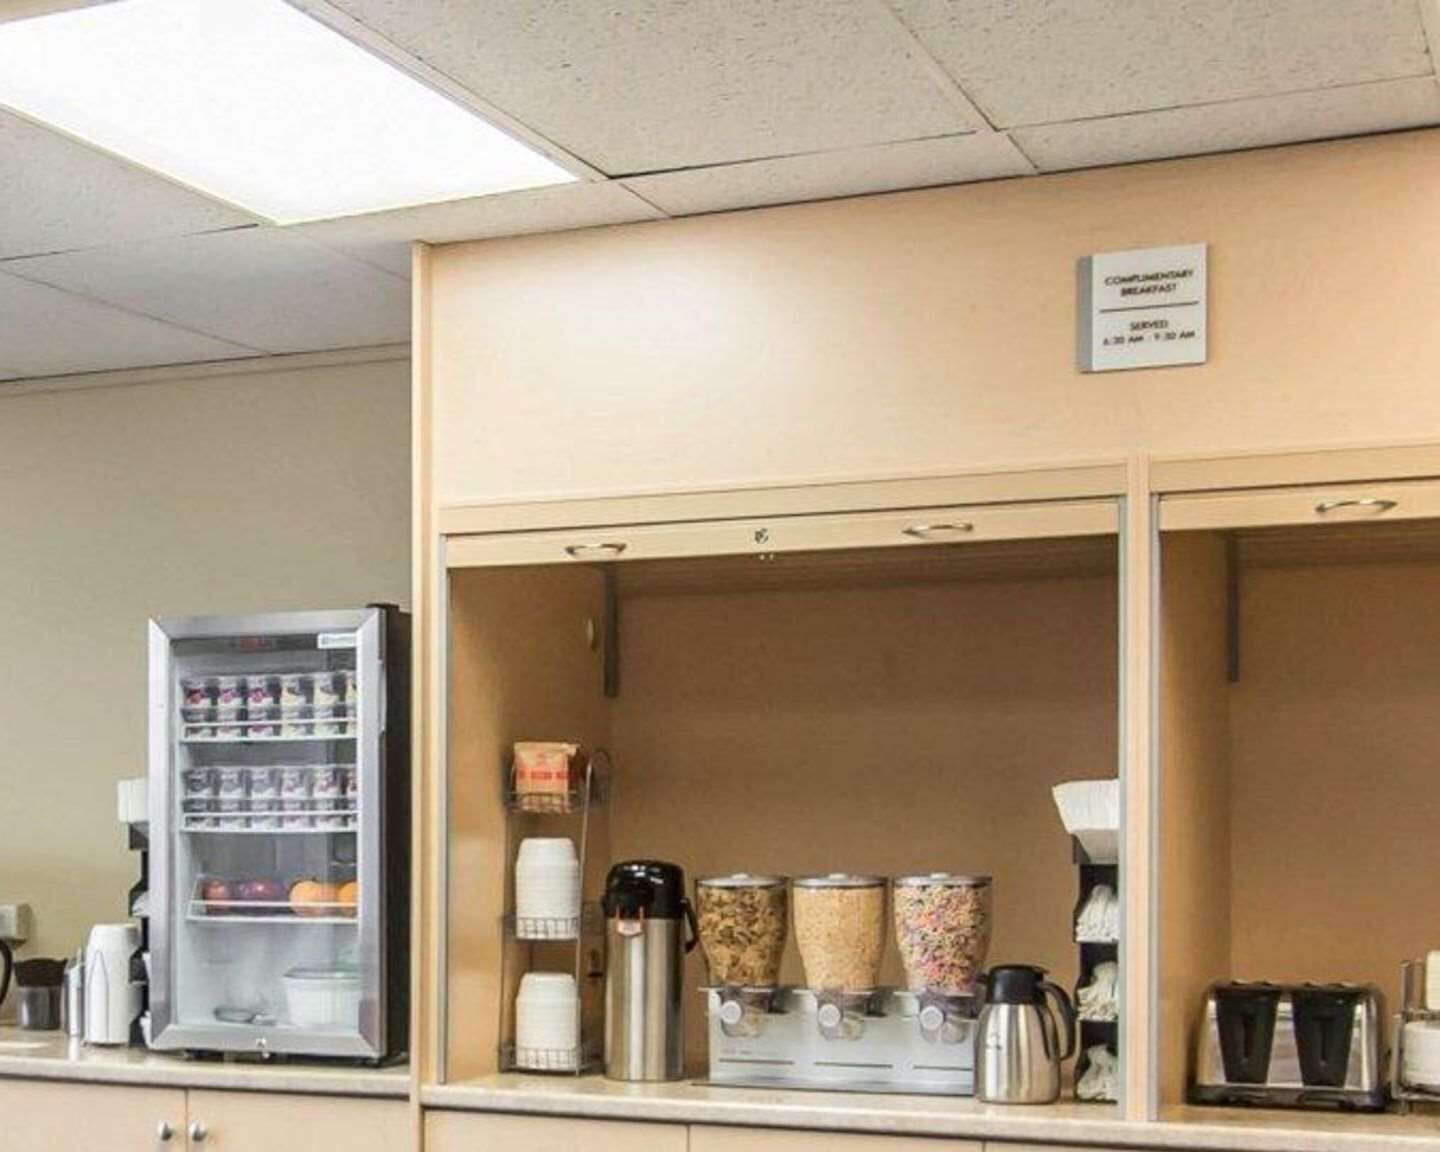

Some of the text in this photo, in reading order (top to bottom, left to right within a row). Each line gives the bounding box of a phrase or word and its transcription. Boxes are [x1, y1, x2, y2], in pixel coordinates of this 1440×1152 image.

[1104, 269, 1193, 286] COMPLIMENTARY
[1121, 283, 1176, 296] BREAKFAST
[1128, 335, 1144, 343] AM
[1179, 330, 1196, 339] AM
